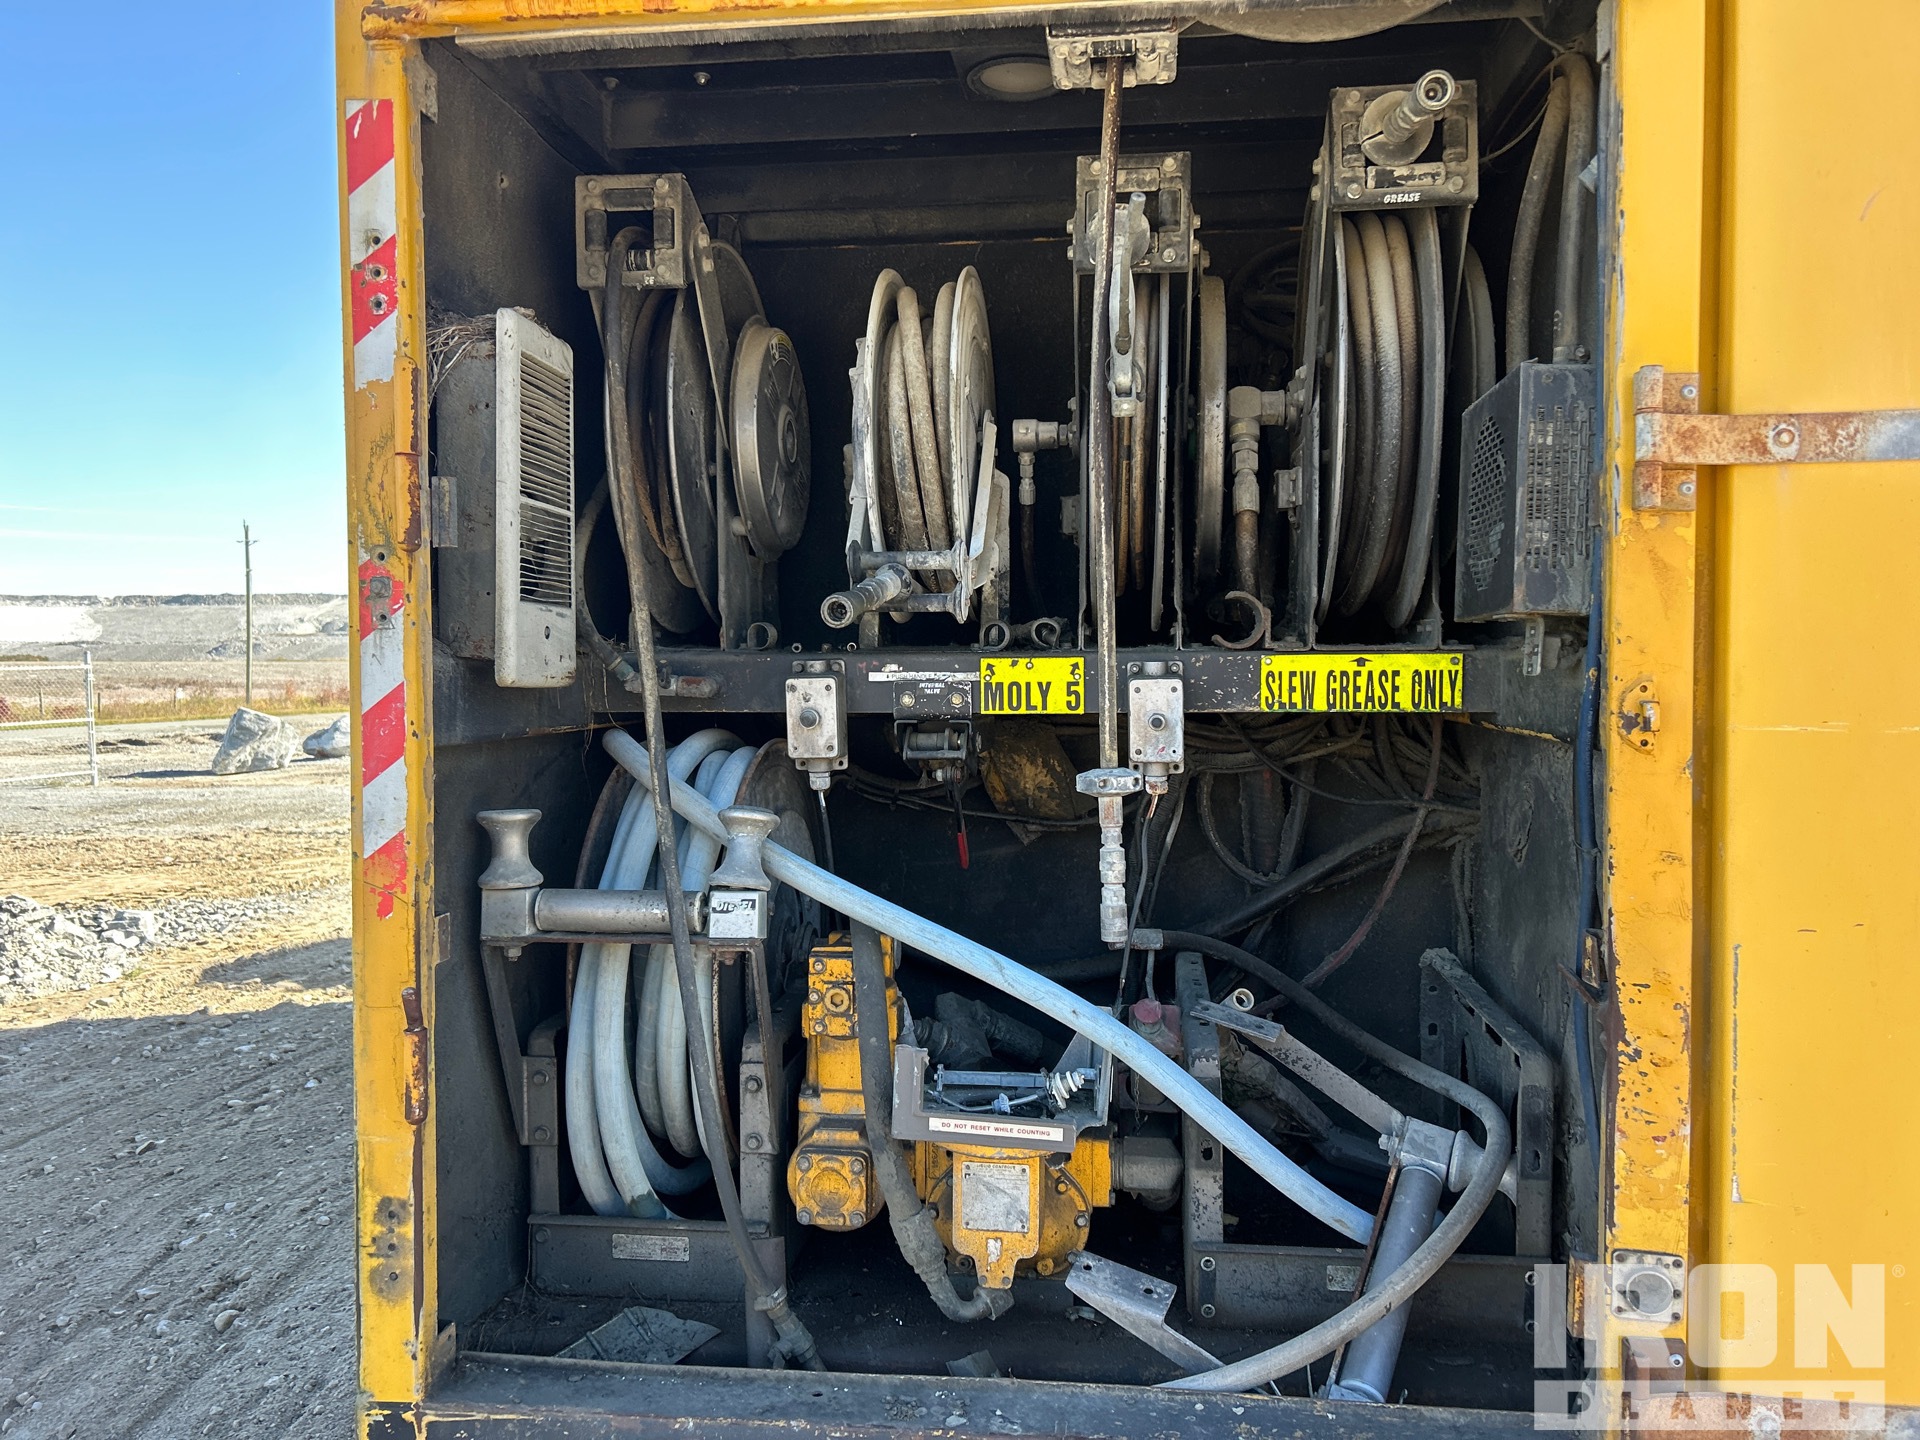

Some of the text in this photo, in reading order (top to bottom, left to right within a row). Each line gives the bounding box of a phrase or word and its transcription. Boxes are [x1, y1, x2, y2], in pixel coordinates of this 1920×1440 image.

[1383, 192, 1421, 204] GREASE
[983, 681, 1081, 712] MOLY 5
[1264, 669, 1459, 710] SLEW GREASE ONLY
[1017, 1128, 1051, 1136] COUNTING
